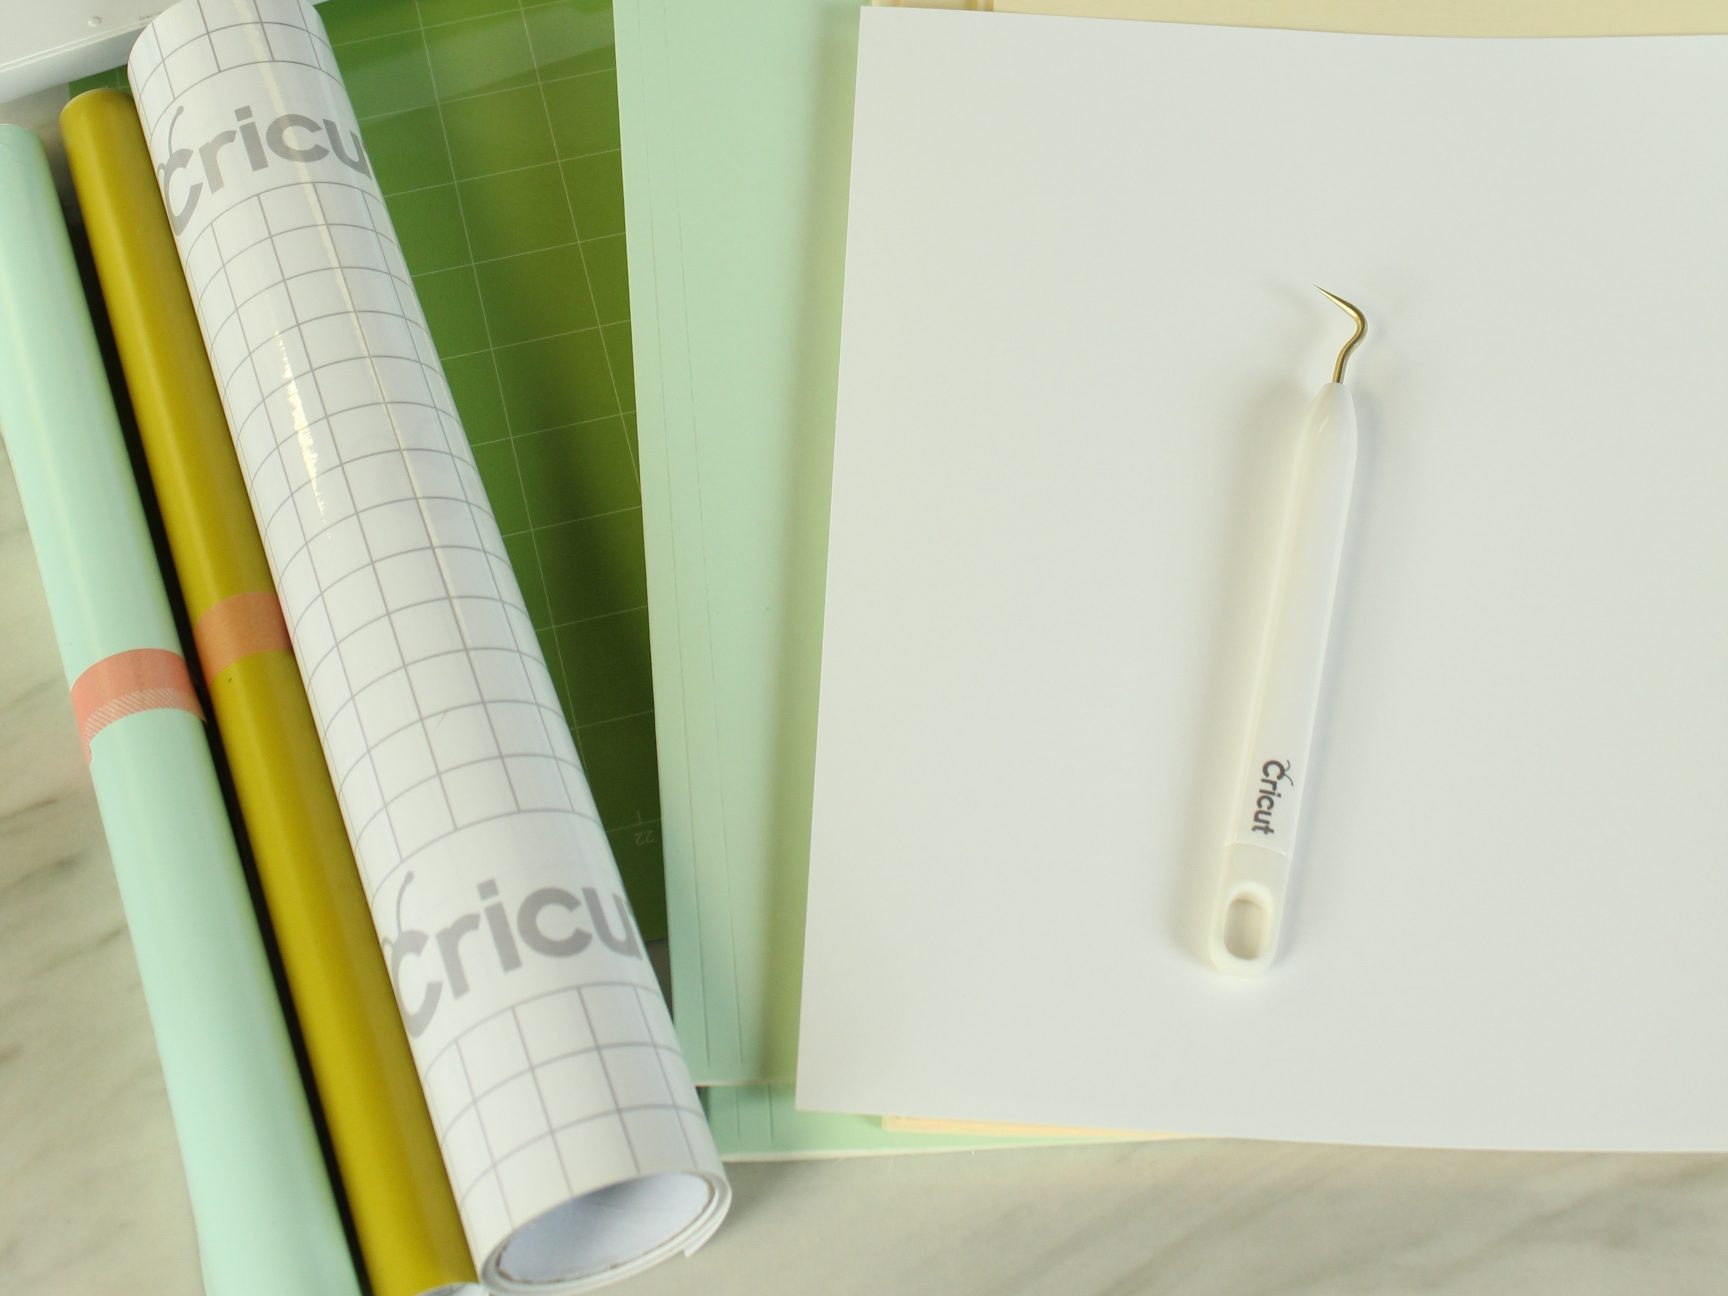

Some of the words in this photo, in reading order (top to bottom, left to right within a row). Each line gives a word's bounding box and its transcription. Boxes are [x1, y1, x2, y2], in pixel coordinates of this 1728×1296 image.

[157, 105, 373, 236] Cricu
[635, 830, 655, 846] 22
[1251, 759, 1294, 835] Cricut
[382, 870, 644, 1038] Cricu
